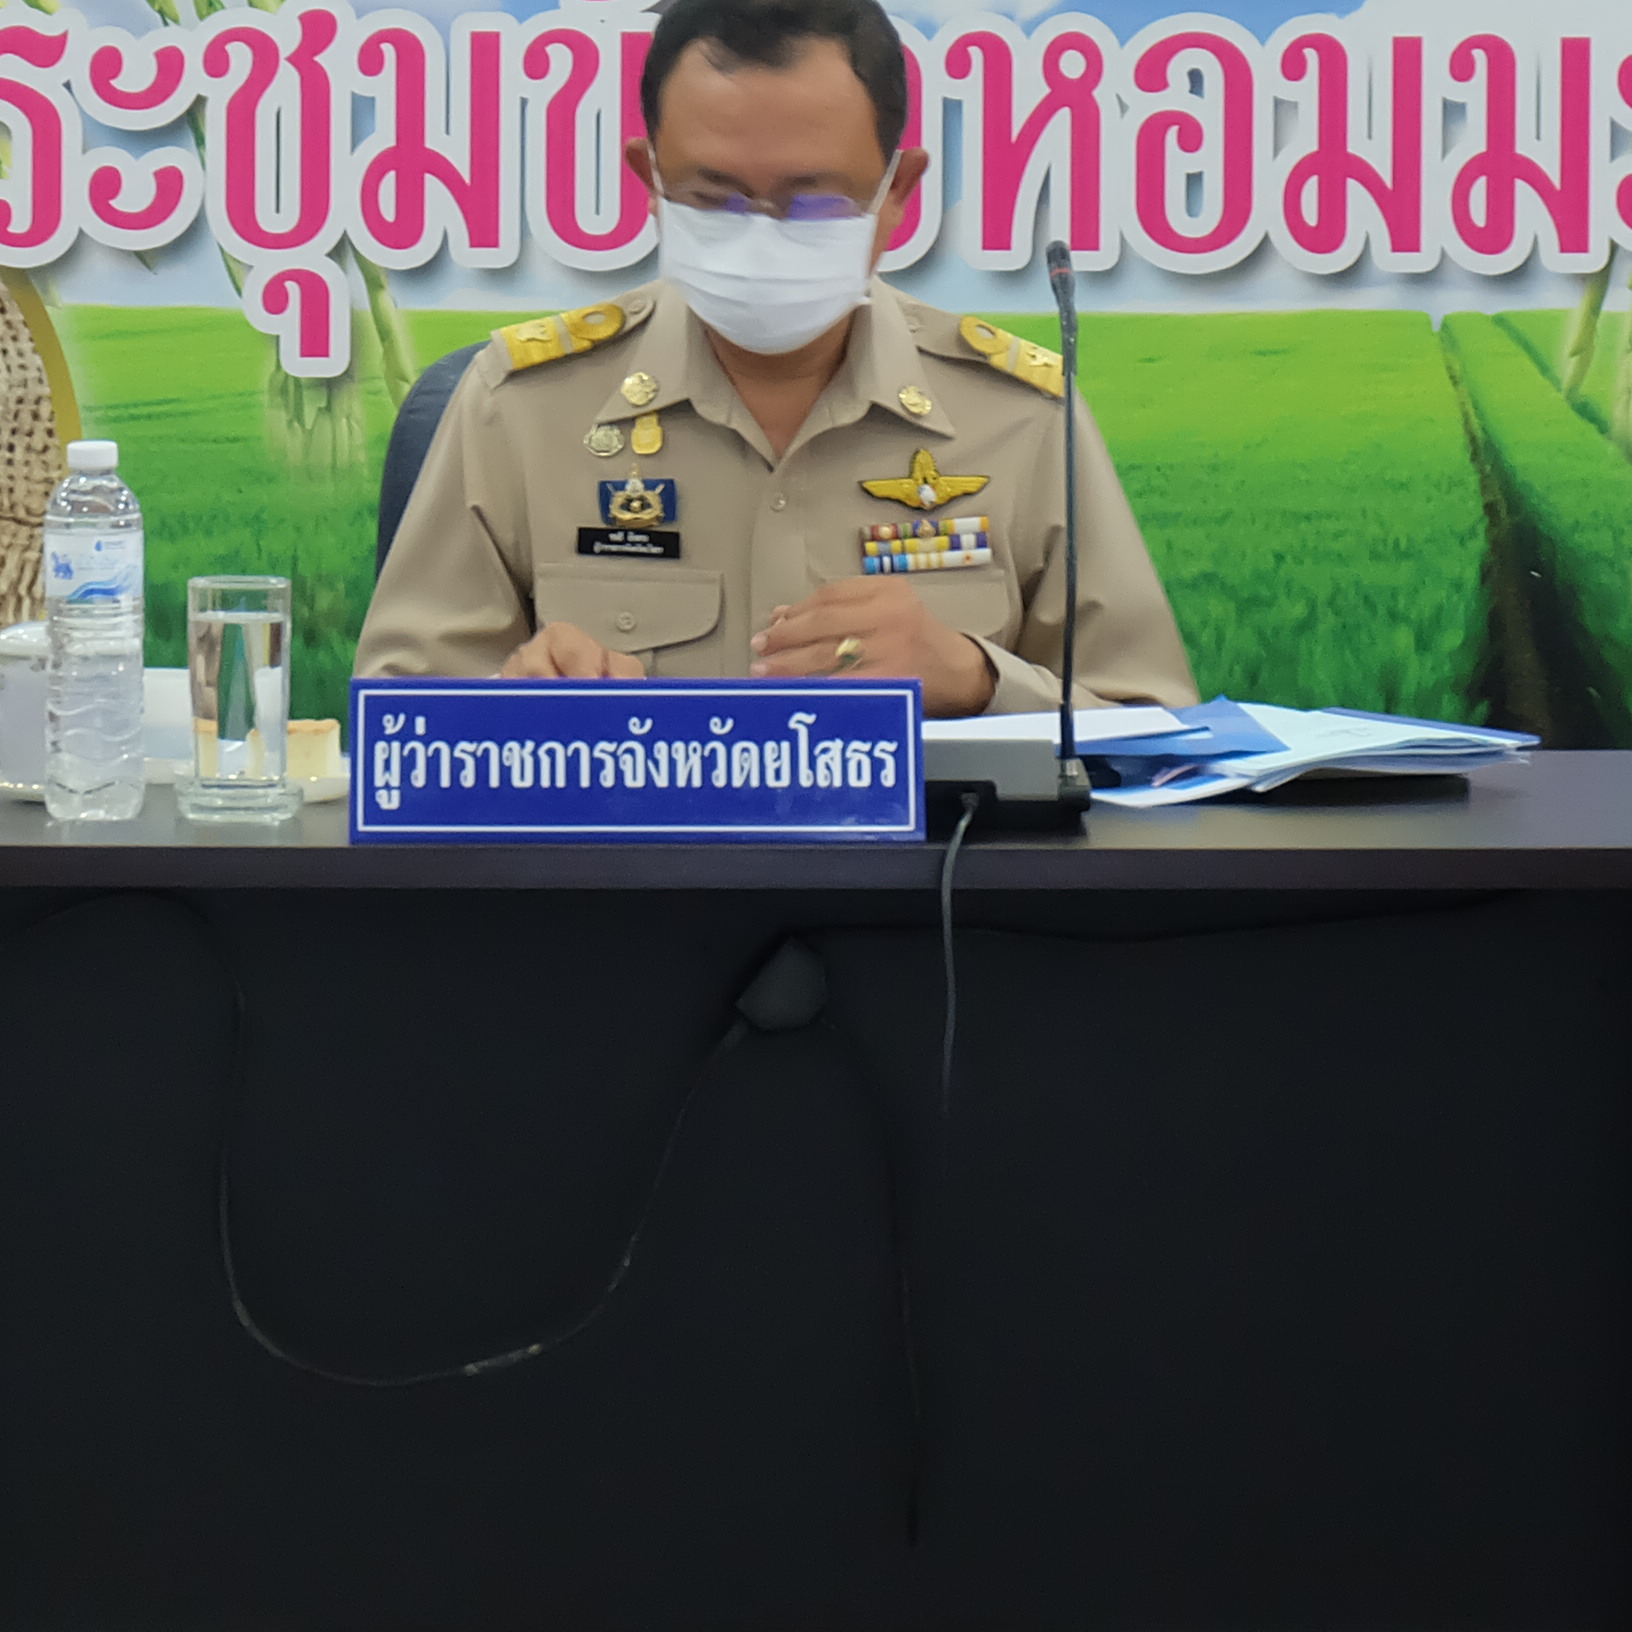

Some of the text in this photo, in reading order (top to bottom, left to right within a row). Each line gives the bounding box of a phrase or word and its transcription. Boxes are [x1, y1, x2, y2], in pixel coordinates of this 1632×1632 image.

[372, 711, 899, 811] ผู้ว่าราชการจังหวัดยโสธร
